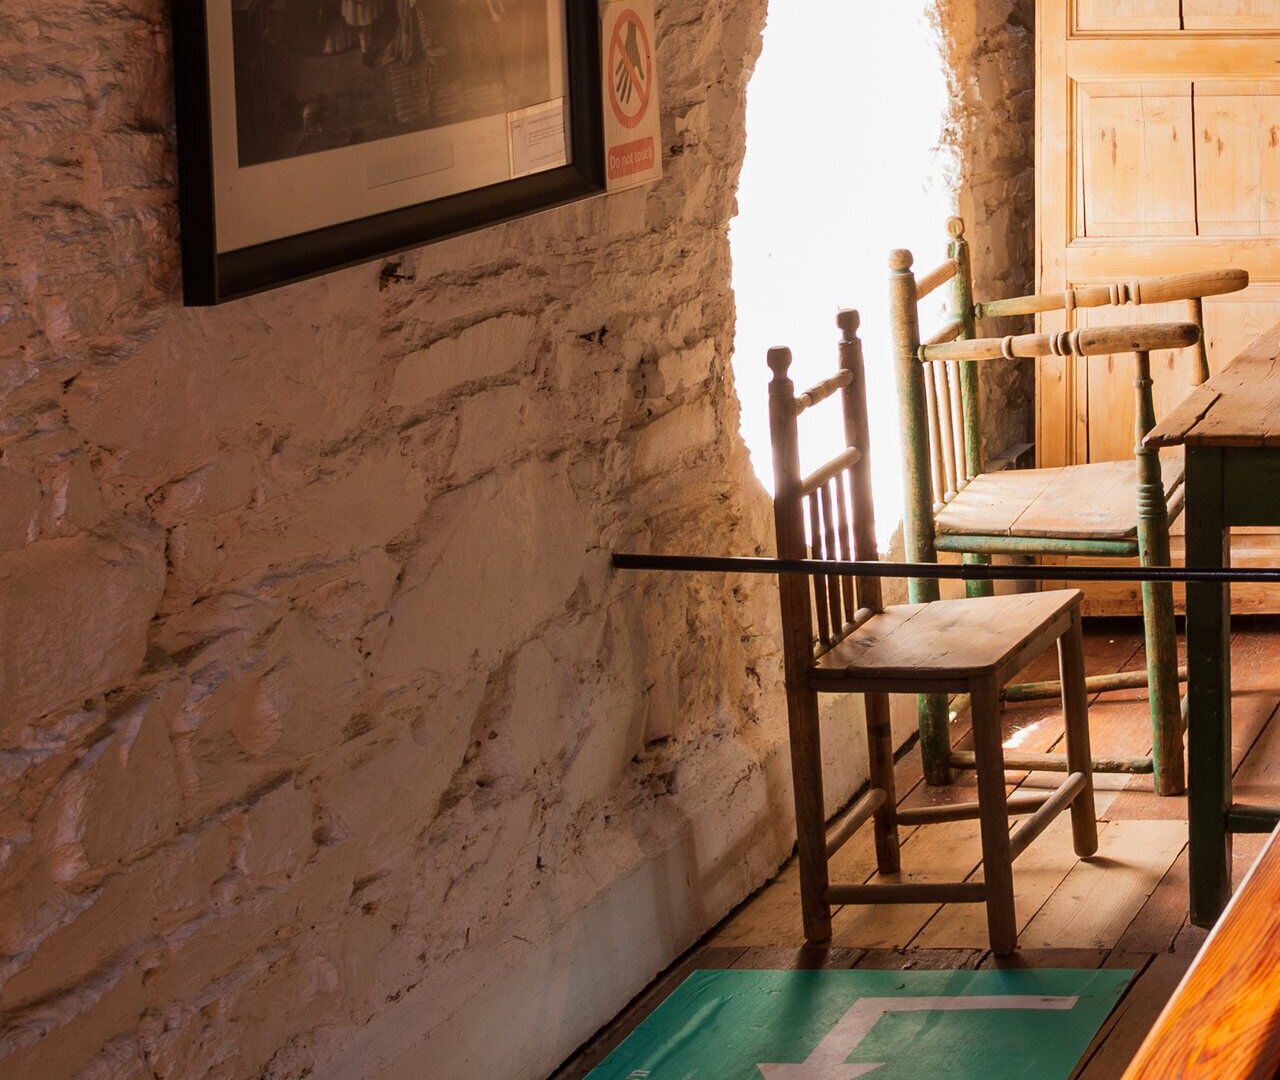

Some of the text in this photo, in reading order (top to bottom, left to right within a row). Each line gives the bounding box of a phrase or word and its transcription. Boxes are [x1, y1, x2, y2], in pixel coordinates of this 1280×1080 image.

[609, 147, 654, 169] Do not touch
